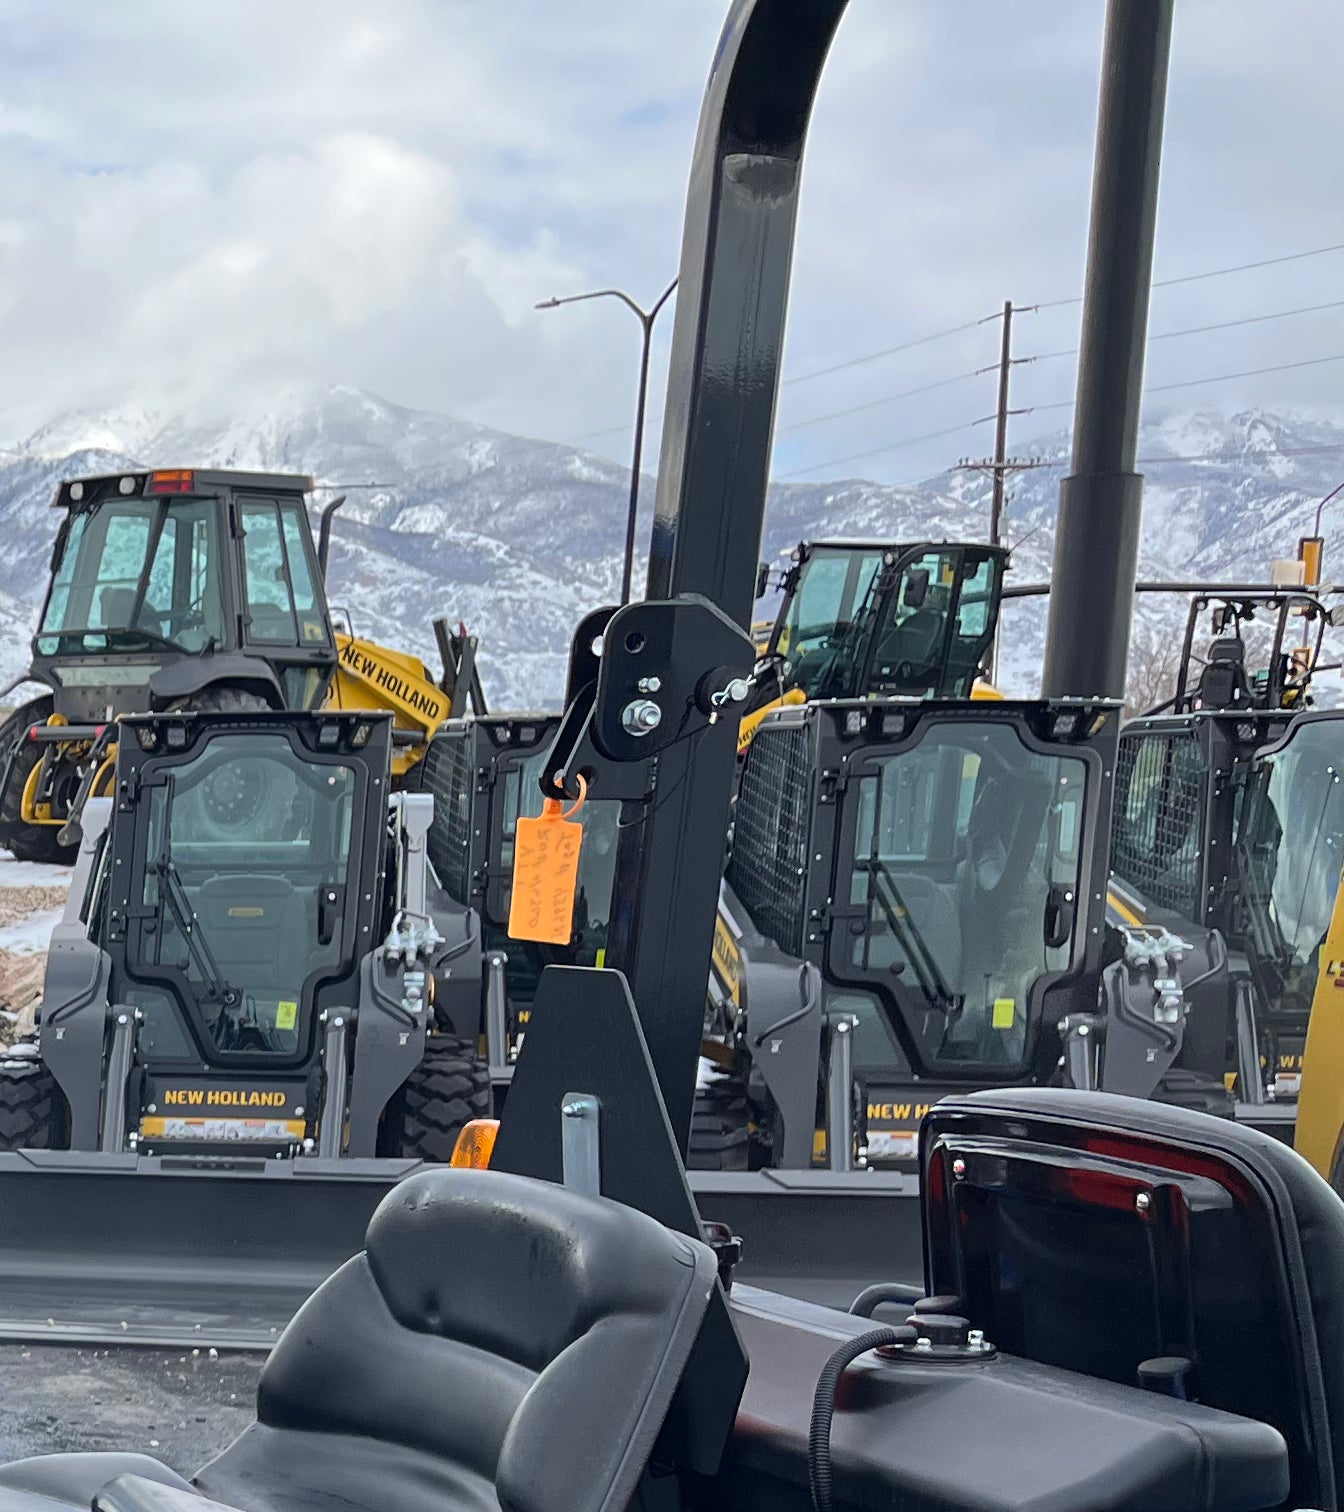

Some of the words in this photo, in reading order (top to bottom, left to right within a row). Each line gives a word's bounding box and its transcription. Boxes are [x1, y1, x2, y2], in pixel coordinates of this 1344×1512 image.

[342, 645, 377, 678] NEW
[375, 667, 440, 719] HOLLAND
[165, 1090, 204, 1105] NEW
[207, 1090, 286, 1107] HOLLAND
[867, 1103, 911, 1119] NEW
